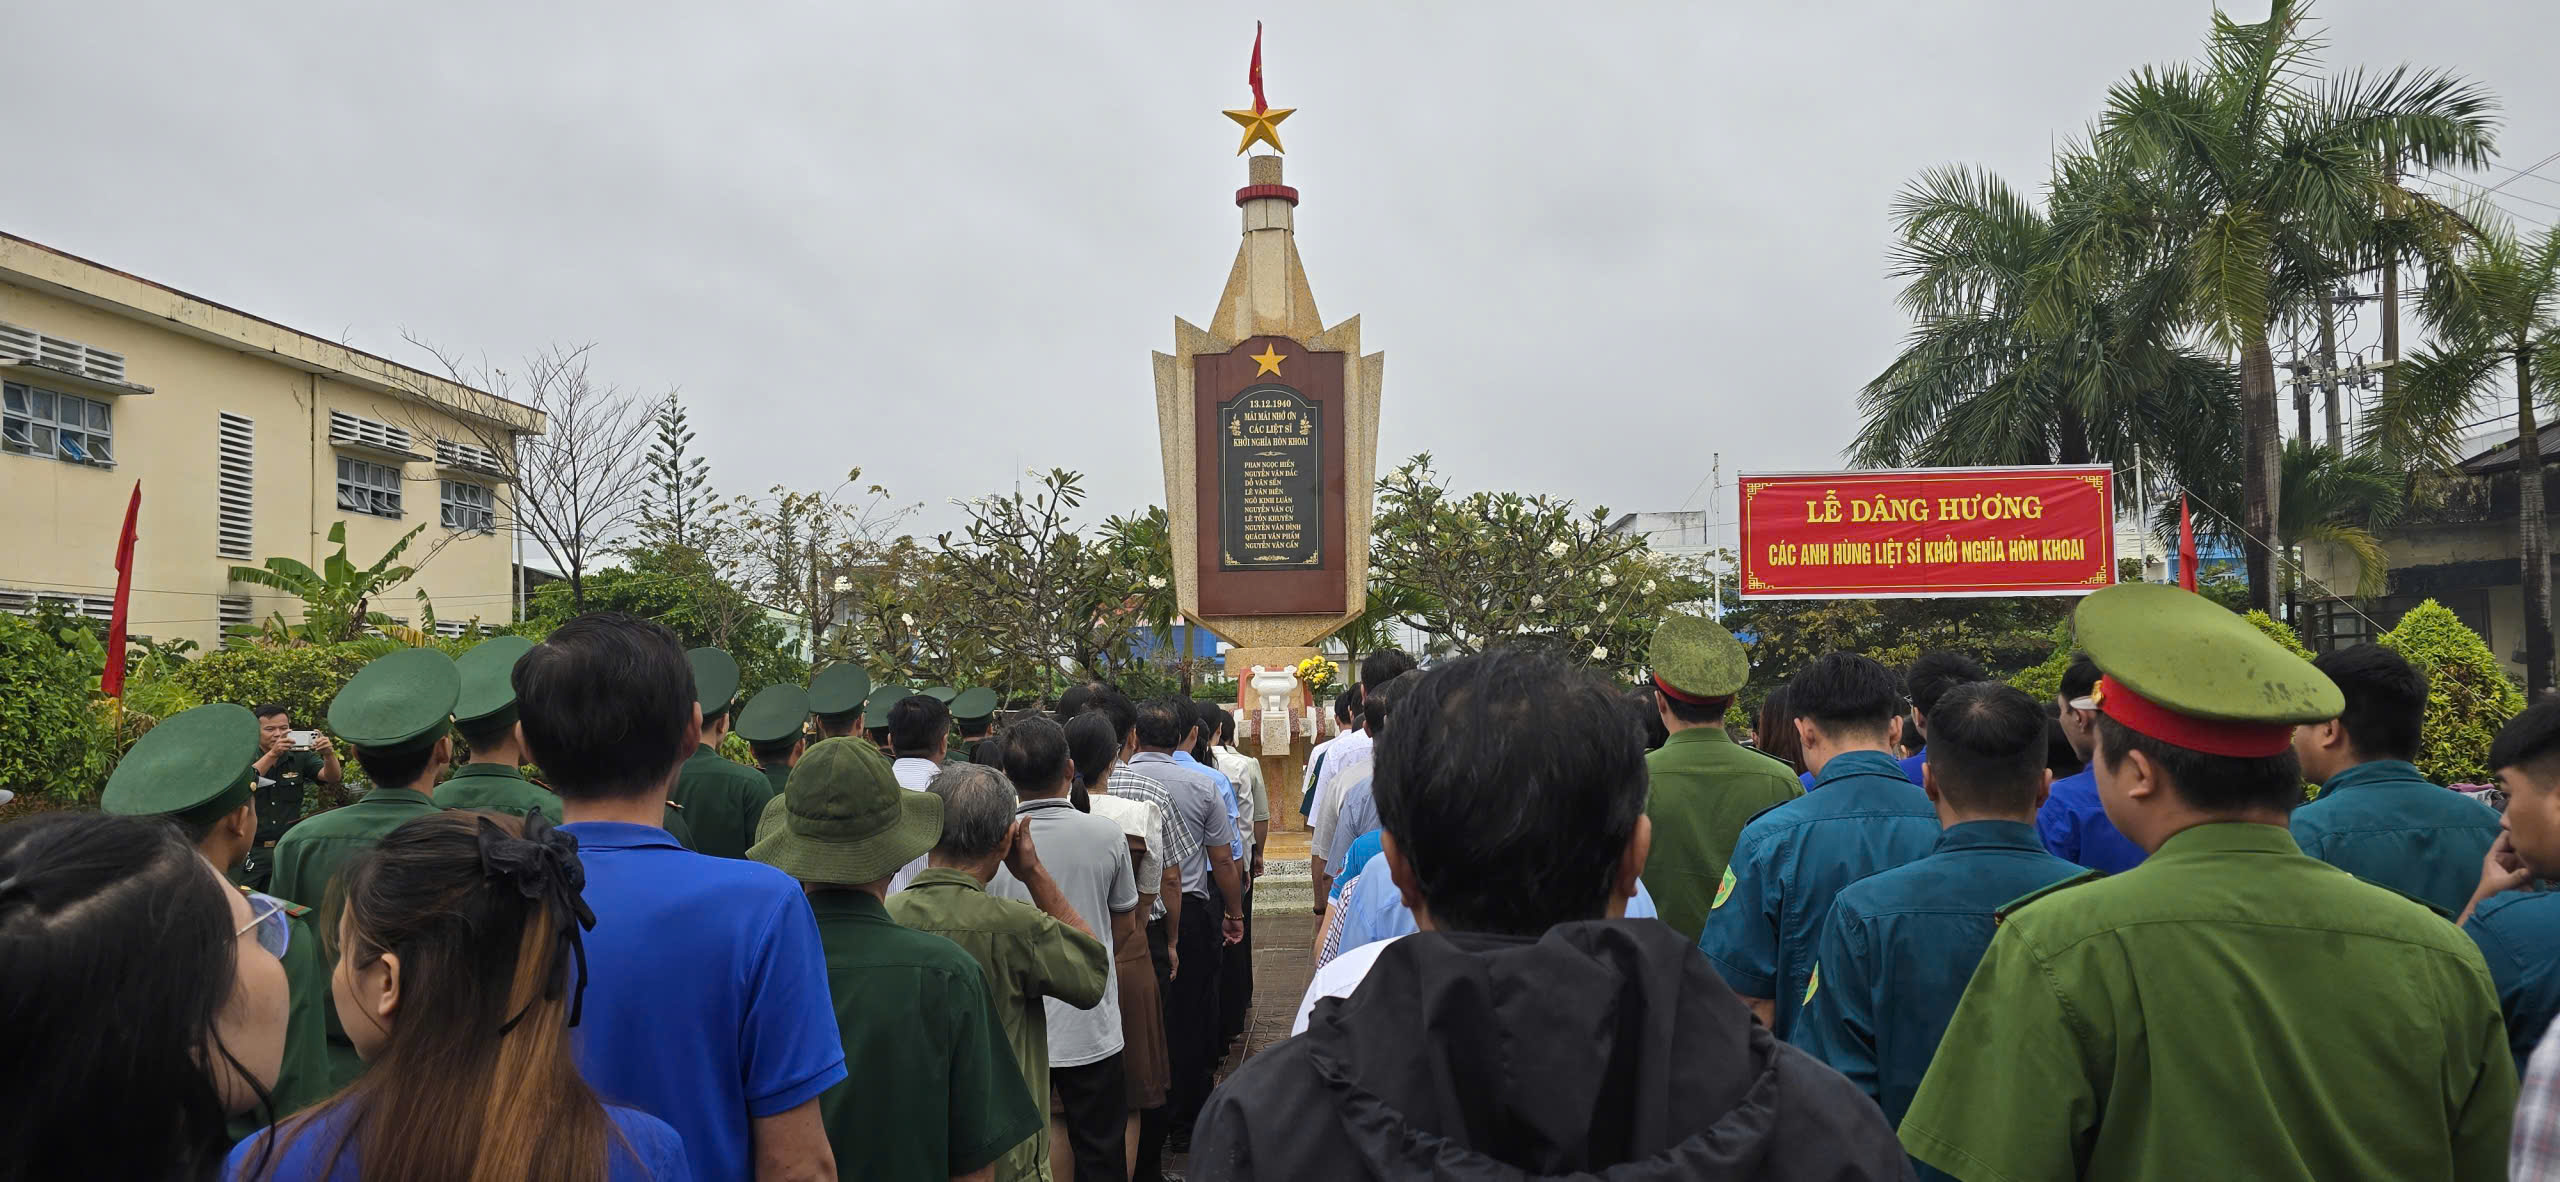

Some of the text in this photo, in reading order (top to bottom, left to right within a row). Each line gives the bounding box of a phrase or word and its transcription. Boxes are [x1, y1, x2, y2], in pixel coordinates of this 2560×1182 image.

[1250, 399, 1291, 408] 13.12.1940
[1249, 423, 1264, 434] CÁC
[1266, 423, 1283, 435] LIỆT
[1233, 435, 1309, 447] KHỞI NGHĨA HÒN KHOAI
[1244, 461, 1261, 469] PHAN
[1262, 461, 1278, 469] NGỌC
[1807, 489, 2044, 523] LỄ DÂNG HƯƠNG
[1769, 534, 2085, 569] CÁC ANH HÙNG LIỆT SĨ KHỞI NGHĨA HÒN KHOAI
